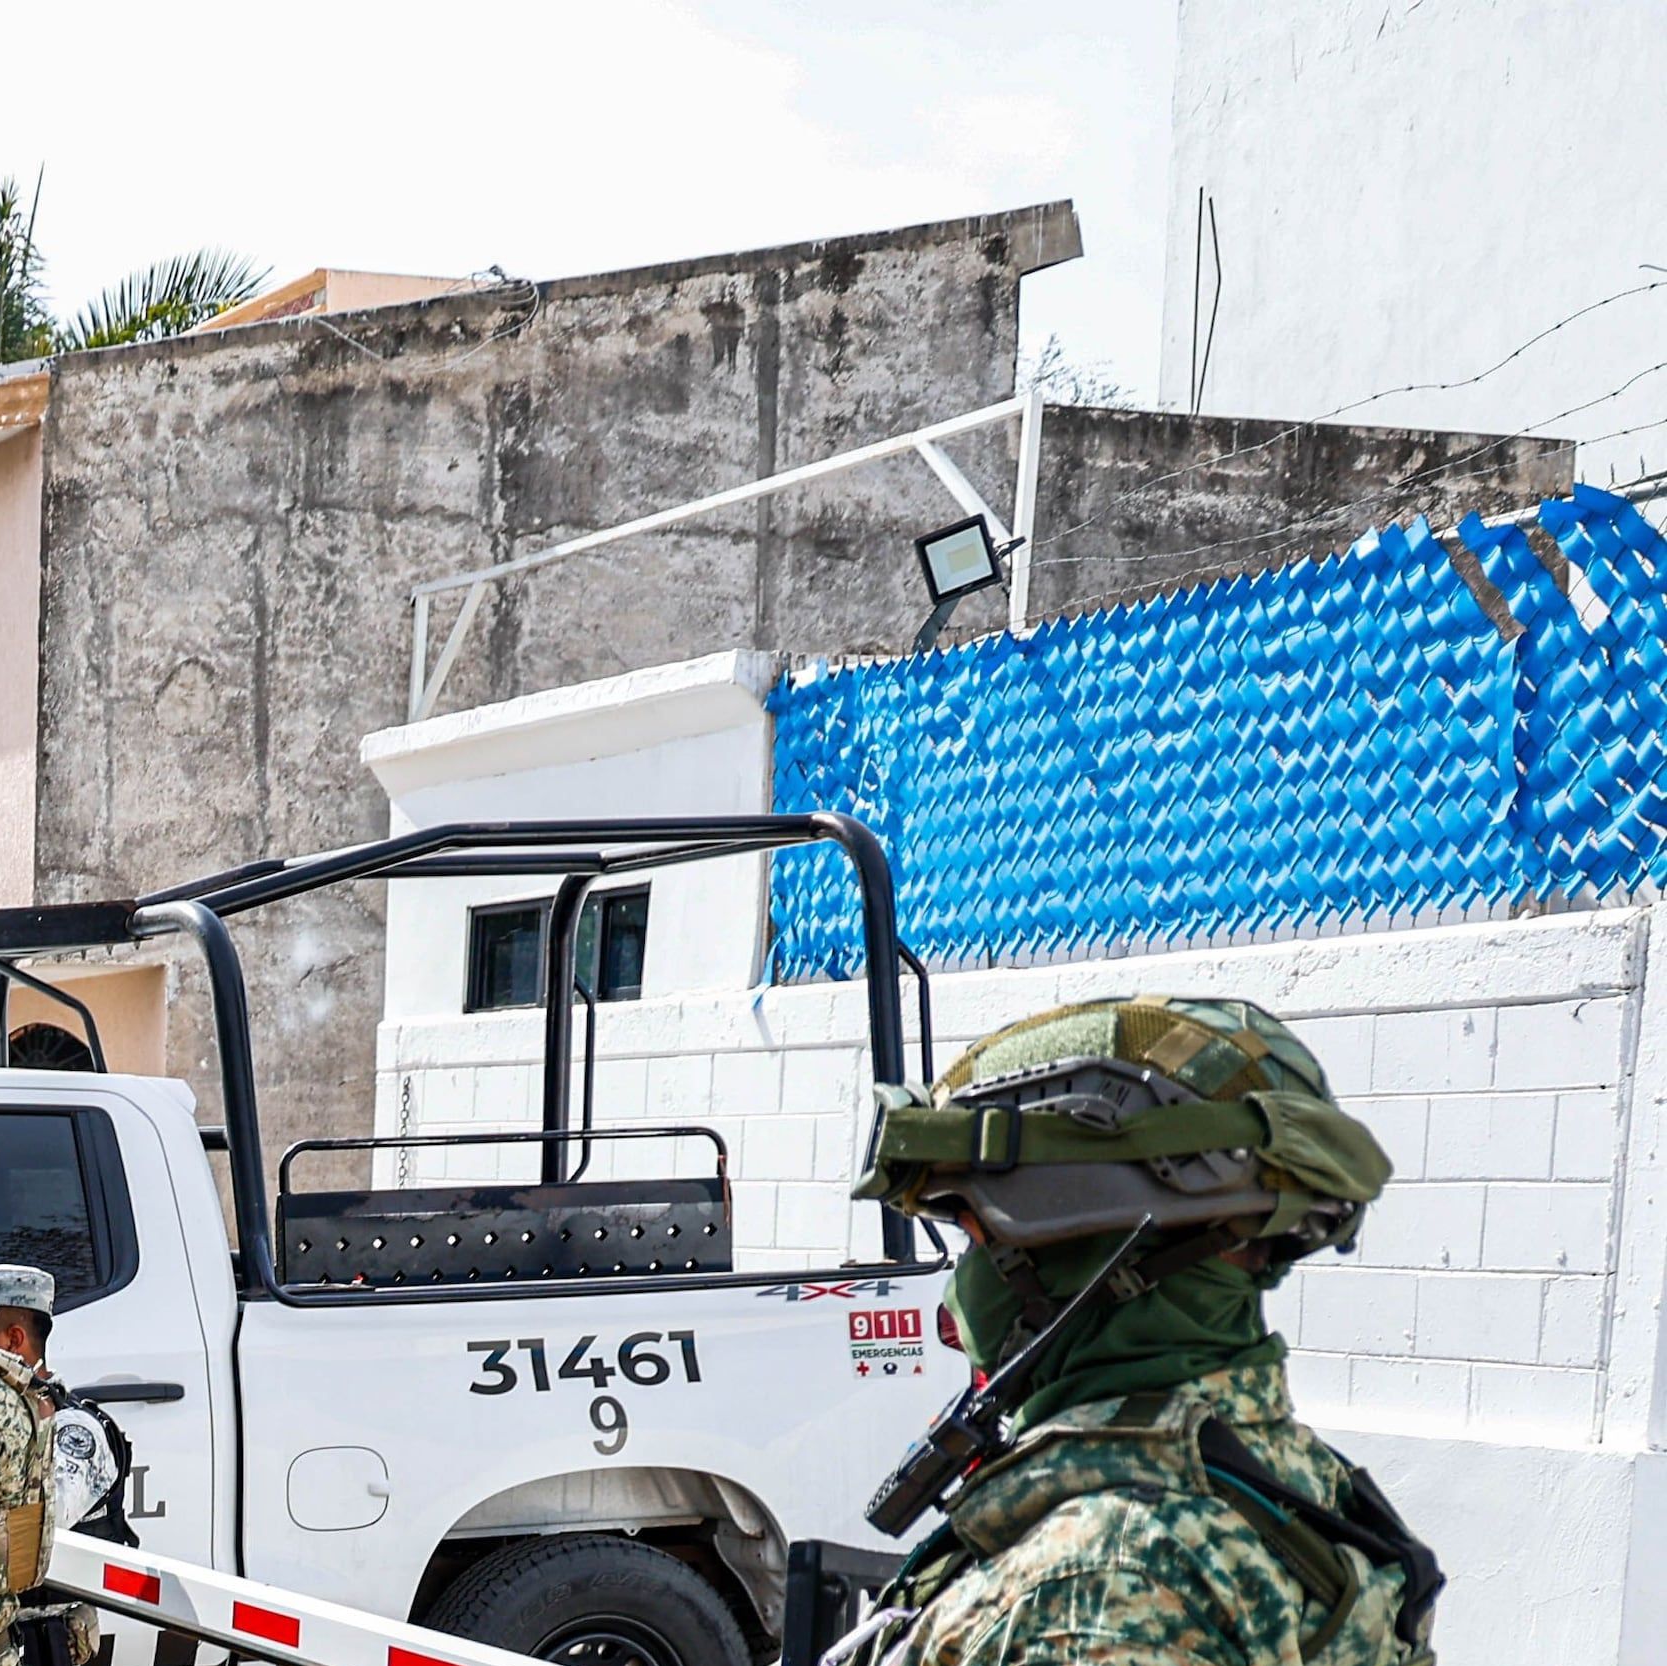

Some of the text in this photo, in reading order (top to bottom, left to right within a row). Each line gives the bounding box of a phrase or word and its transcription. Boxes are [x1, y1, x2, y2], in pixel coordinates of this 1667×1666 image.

[852, 1312, 917, 1338] 911
[467, 1330, 701, 1395] 31461
[852, 1347, 924, 1359] EMERGENCIAS
[589, 1395, 628, 1456] 9
